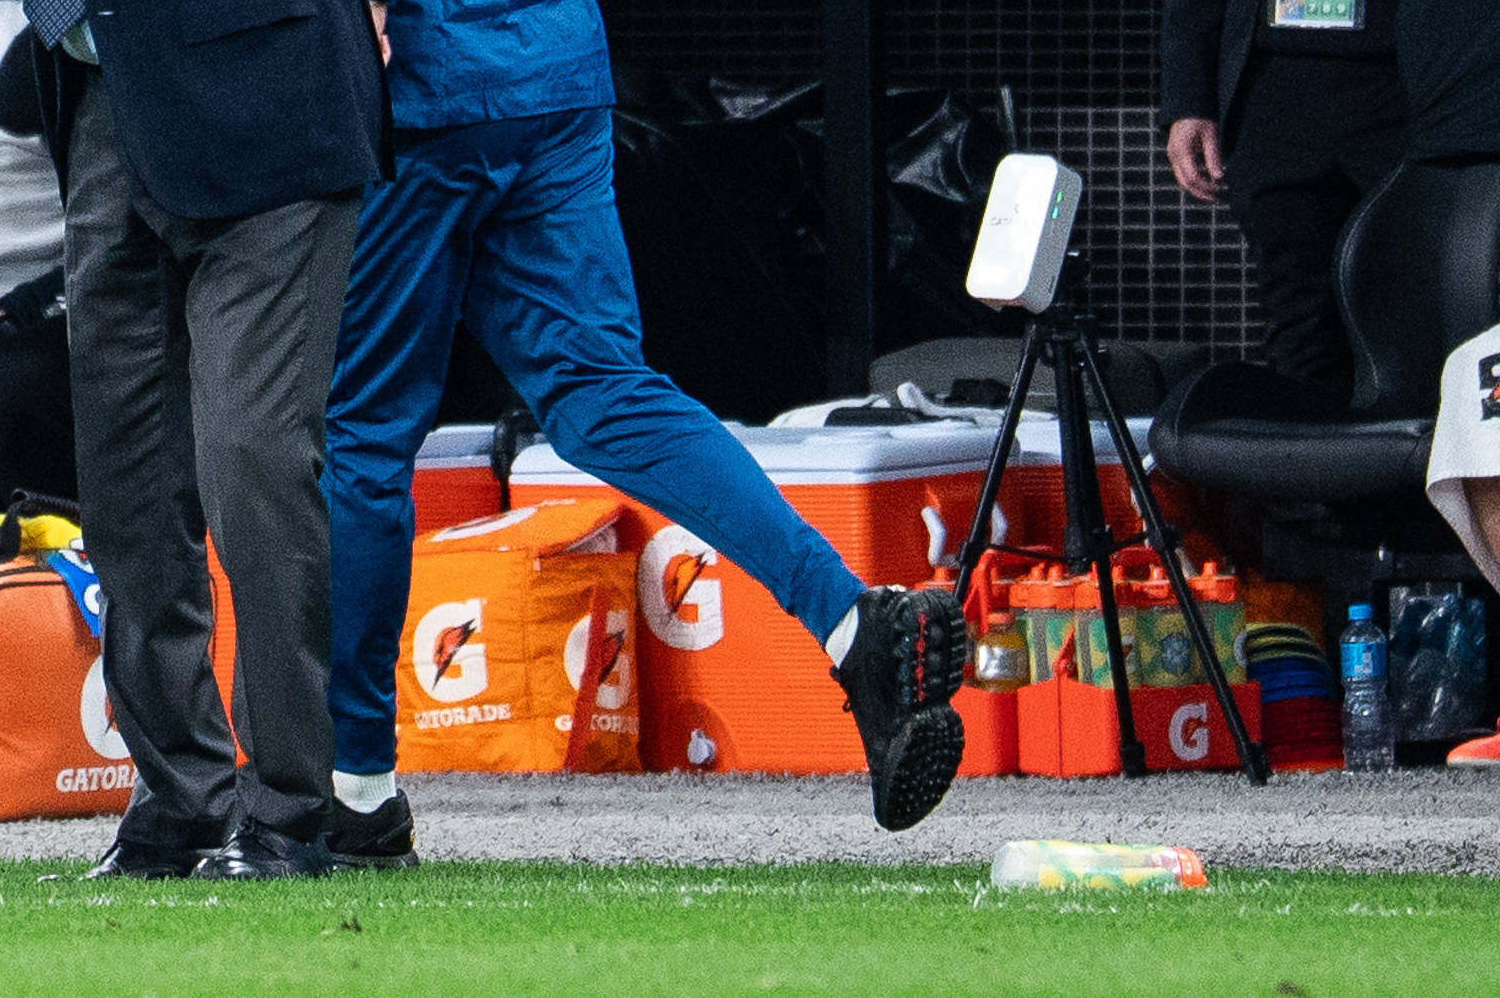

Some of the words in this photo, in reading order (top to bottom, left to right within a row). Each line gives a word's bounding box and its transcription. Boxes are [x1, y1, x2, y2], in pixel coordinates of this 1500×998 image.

[637, 522, 725, 652] G
[412, 598, 488, 703] G
[1169, 703, 1209, 761] G
[55, 764, 138, 793] GATOR
